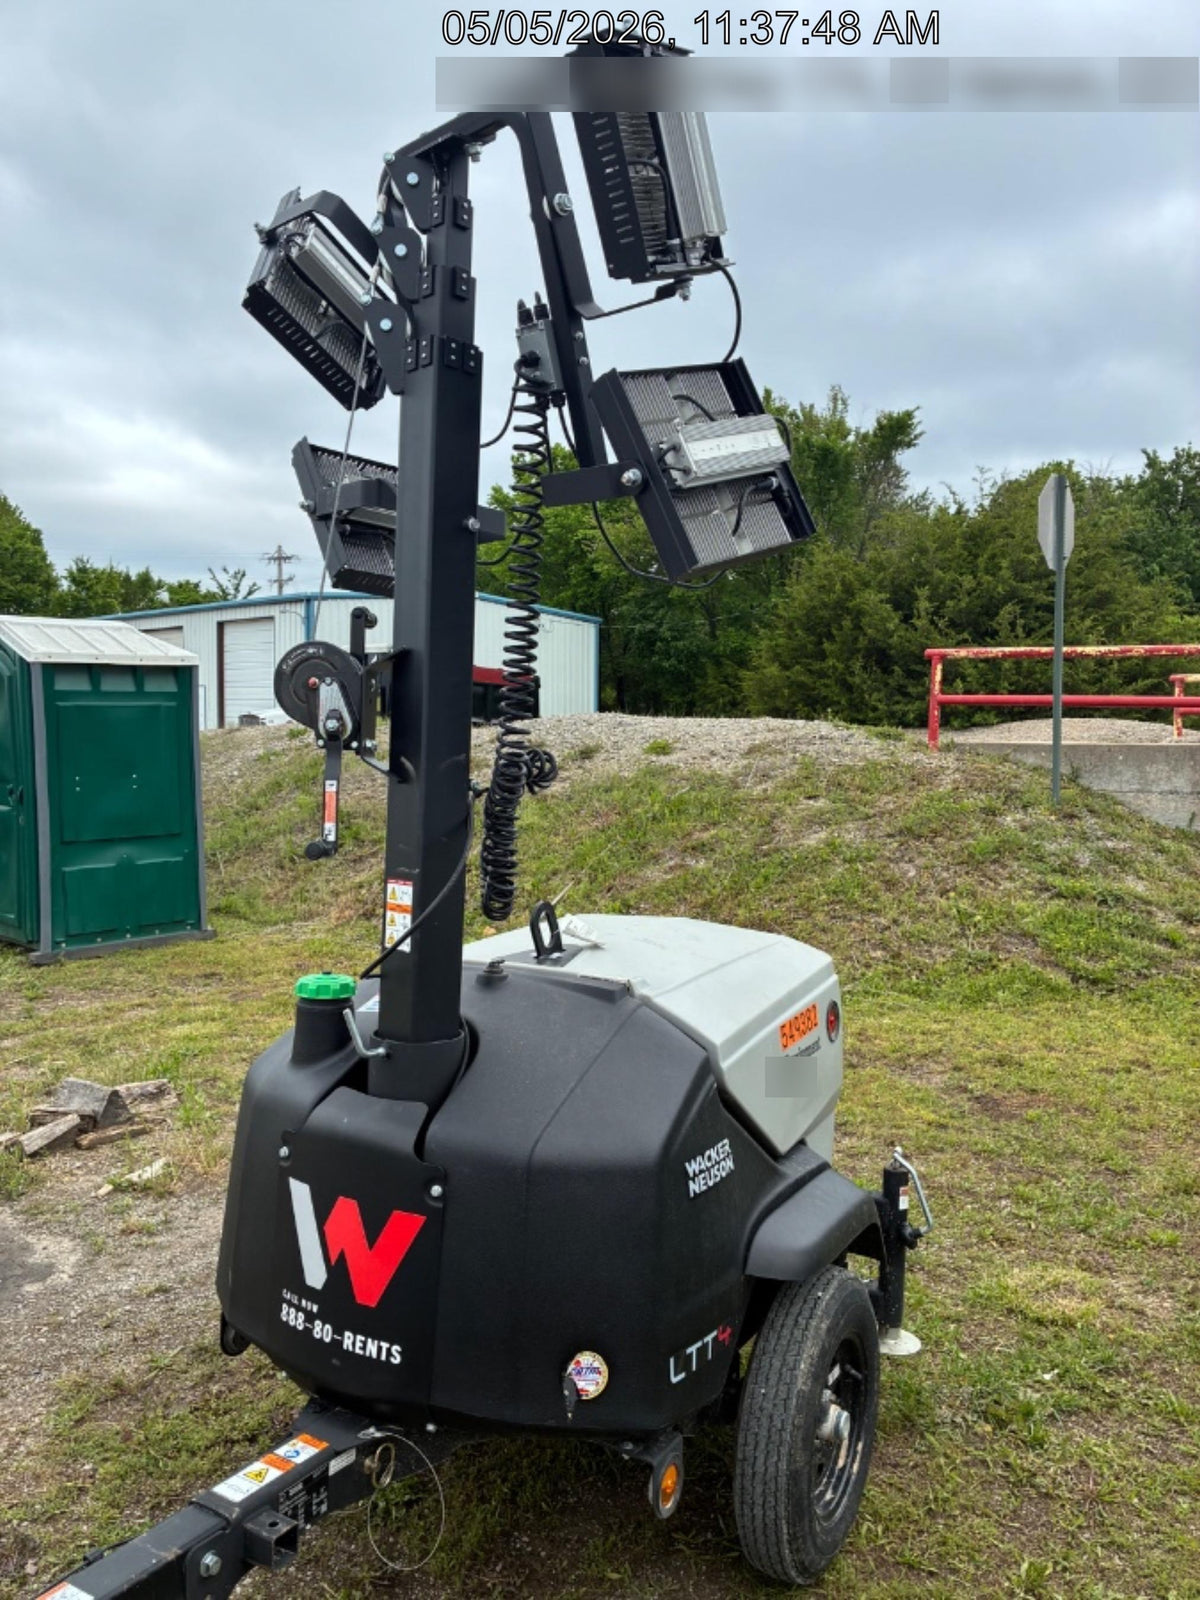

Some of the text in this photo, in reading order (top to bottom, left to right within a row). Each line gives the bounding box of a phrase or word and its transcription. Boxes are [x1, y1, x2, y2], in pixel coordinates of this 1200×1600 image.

[684, 1138, 732, 1178] WACKER
[688, 1155, 735, 1198] NEUSON
[280, 1302, 402, 1365] 888-80-RENTS
[669, 1325, 733, 1385] LTT4
